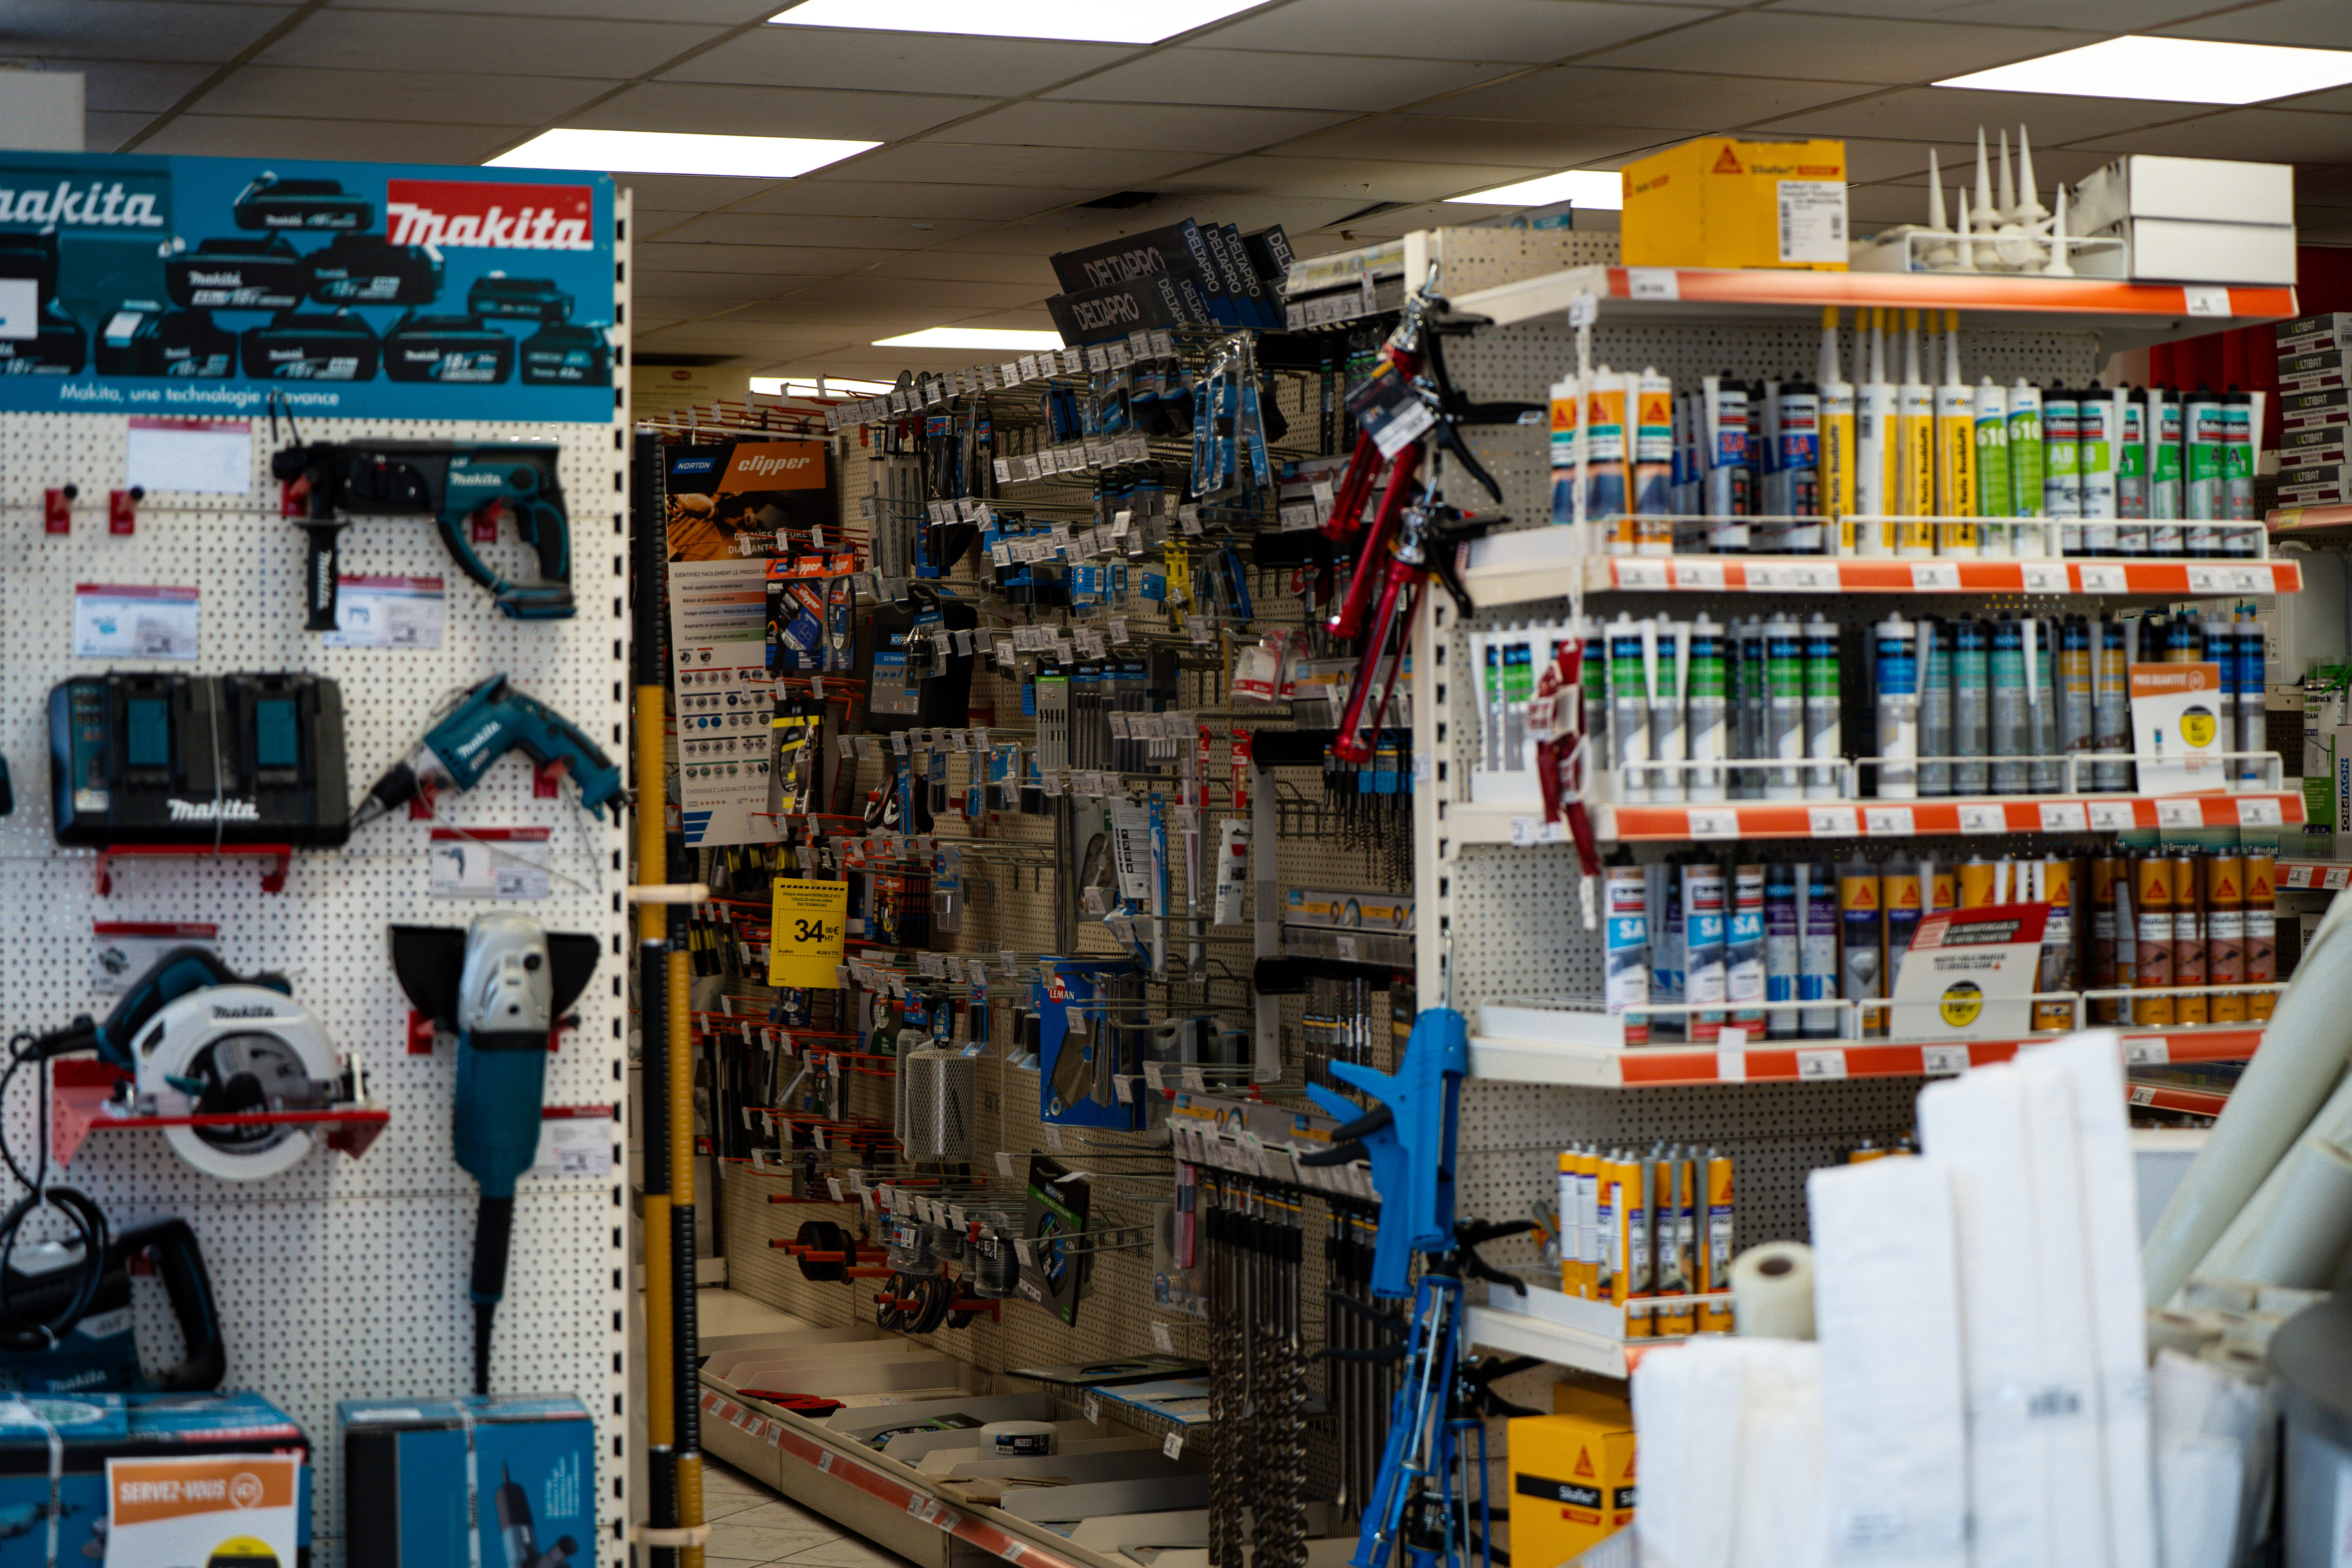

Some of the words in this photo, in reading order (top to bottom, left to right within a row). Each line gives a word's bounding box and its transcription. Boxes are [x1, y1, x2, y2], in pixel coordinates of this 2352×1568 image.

[1185, 227, 1220, 293] DELTAPRO
[1206, 229, 1242, 294] DELTAPRO
[1226, 233, 1261, 298] DELTAPRO
[1268, 232, 1294, 279] DELT
[1083, 246, 1166, 288] DELTAPRO
[1072, 292, 1139, 331] DELTAPRO
[2291, 320, 2315, 333] ULTIBAT
[2295, 357, 2322, 370] ULTIBAT
[60, 382, 124, 405] Makita,
[129, 389, 161, 402] une
[167, 383, 261, 408] technologie
[2299, 394, 2327, 407] ULTIBAT
[2010, 420, 2041, 440] 610
[2296, 432, 2323, 445] ULTIBAT
[737, 456, 811, 476] clipper
[2294, 470, 2319, 483] ULTIBAT
[735, 532, 773, 541] DQUES
[798, 588, 821, 609] clipper
[2169, 843, 2199, 853] Granulat
[885, 879, 900, 890] clipper
[794, 919, 824, 942] 34
[1050, 989, 1074, 1000] LEMAN
[1046, 1185, 1064, 1201] NOVIPRO
[1051, 1256, 1064, 1280] NOVIPRO
[121, 1478, 227, 1504] SERVEZ-VOUS
